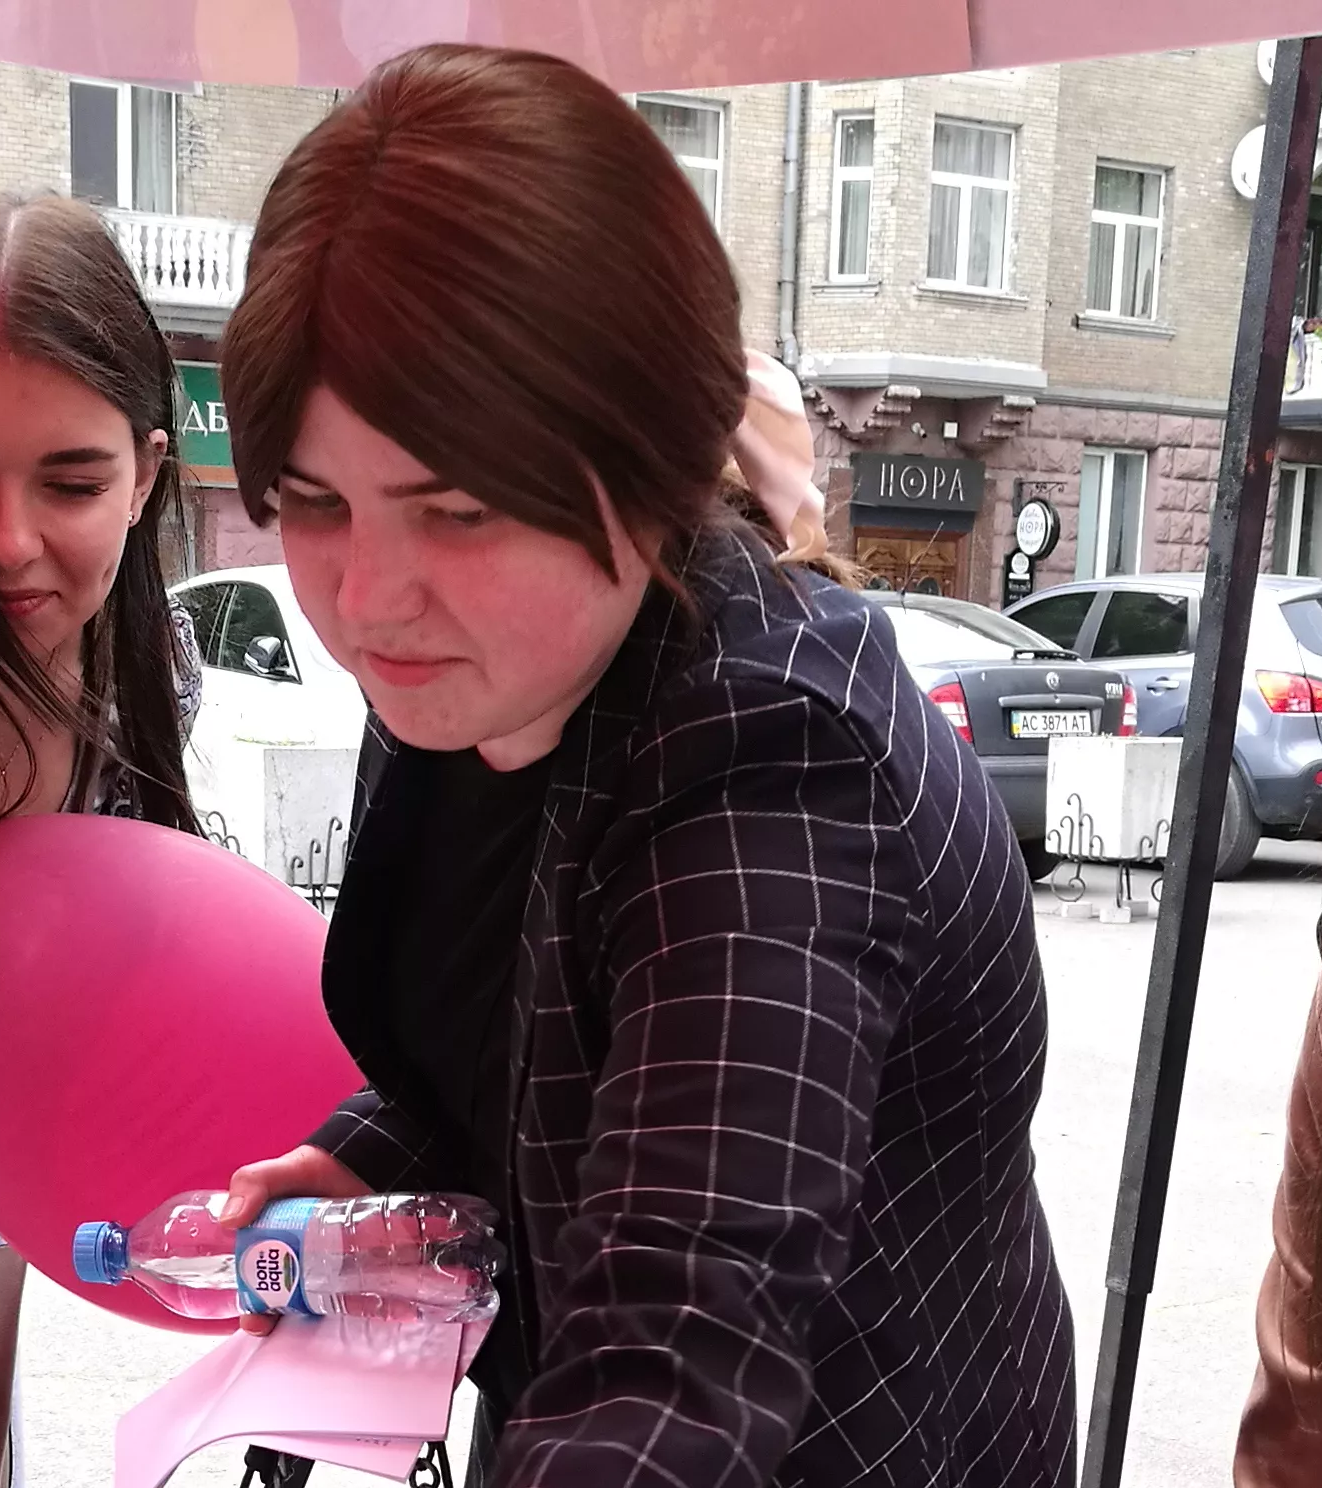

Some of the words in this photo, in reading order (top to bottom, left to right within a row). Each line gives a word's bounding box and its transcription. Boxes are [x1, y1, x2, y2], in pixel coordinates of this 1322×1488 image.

[1021, 715, 1038, 731] AC
[1041, 715, 1068, 731] 3871
[1071, 715, 1087, 731] AT
[256, 1259, 269, 1291] bon
[268, 1248, 283, 1292] aqua
